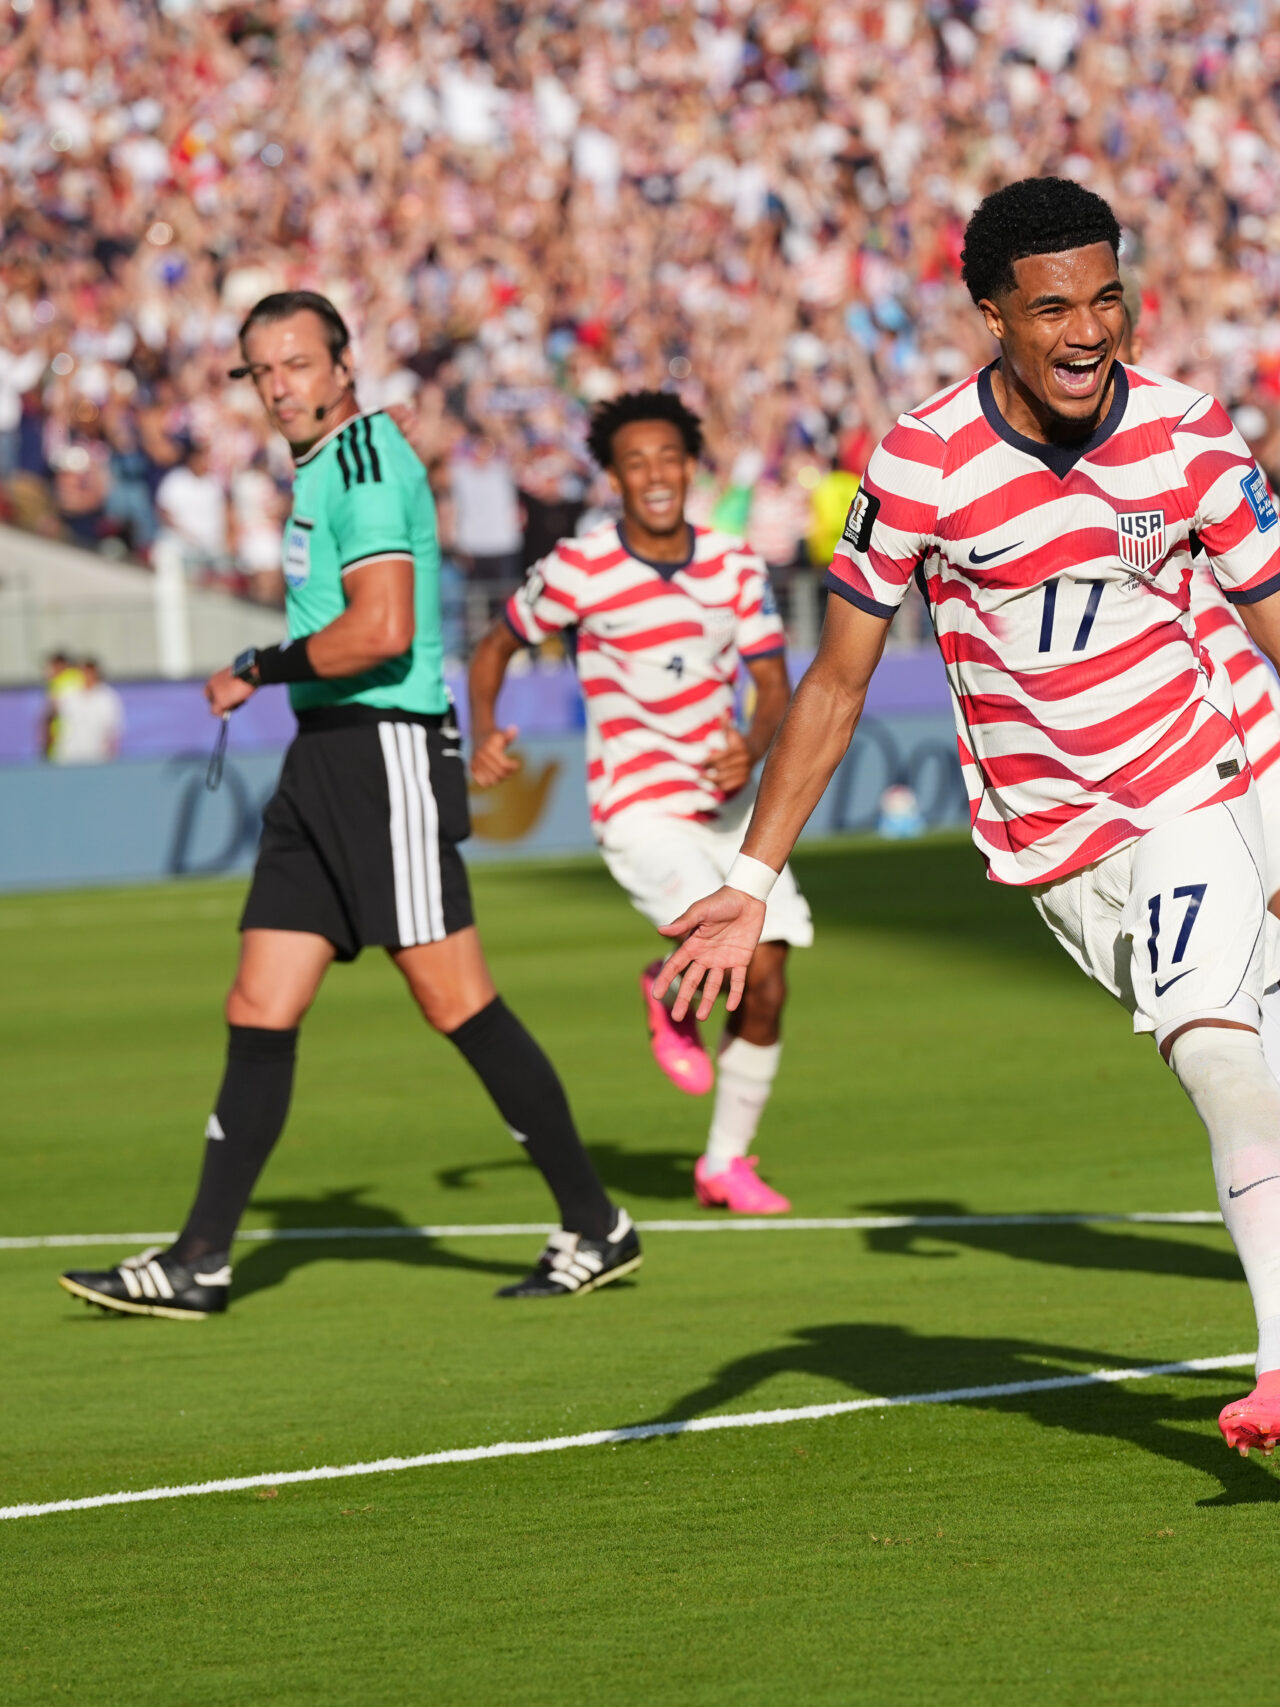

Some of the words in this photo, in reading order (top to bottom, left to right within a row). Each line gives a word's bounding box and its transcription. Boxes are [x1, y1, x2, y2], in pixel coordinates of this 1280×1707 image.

[1120, 513, 1162, 539] USA
[1038, 577, 1106, 653] 17
[666, 656, 683, 679] 4
[1147, 883, 1208, 974] 17
